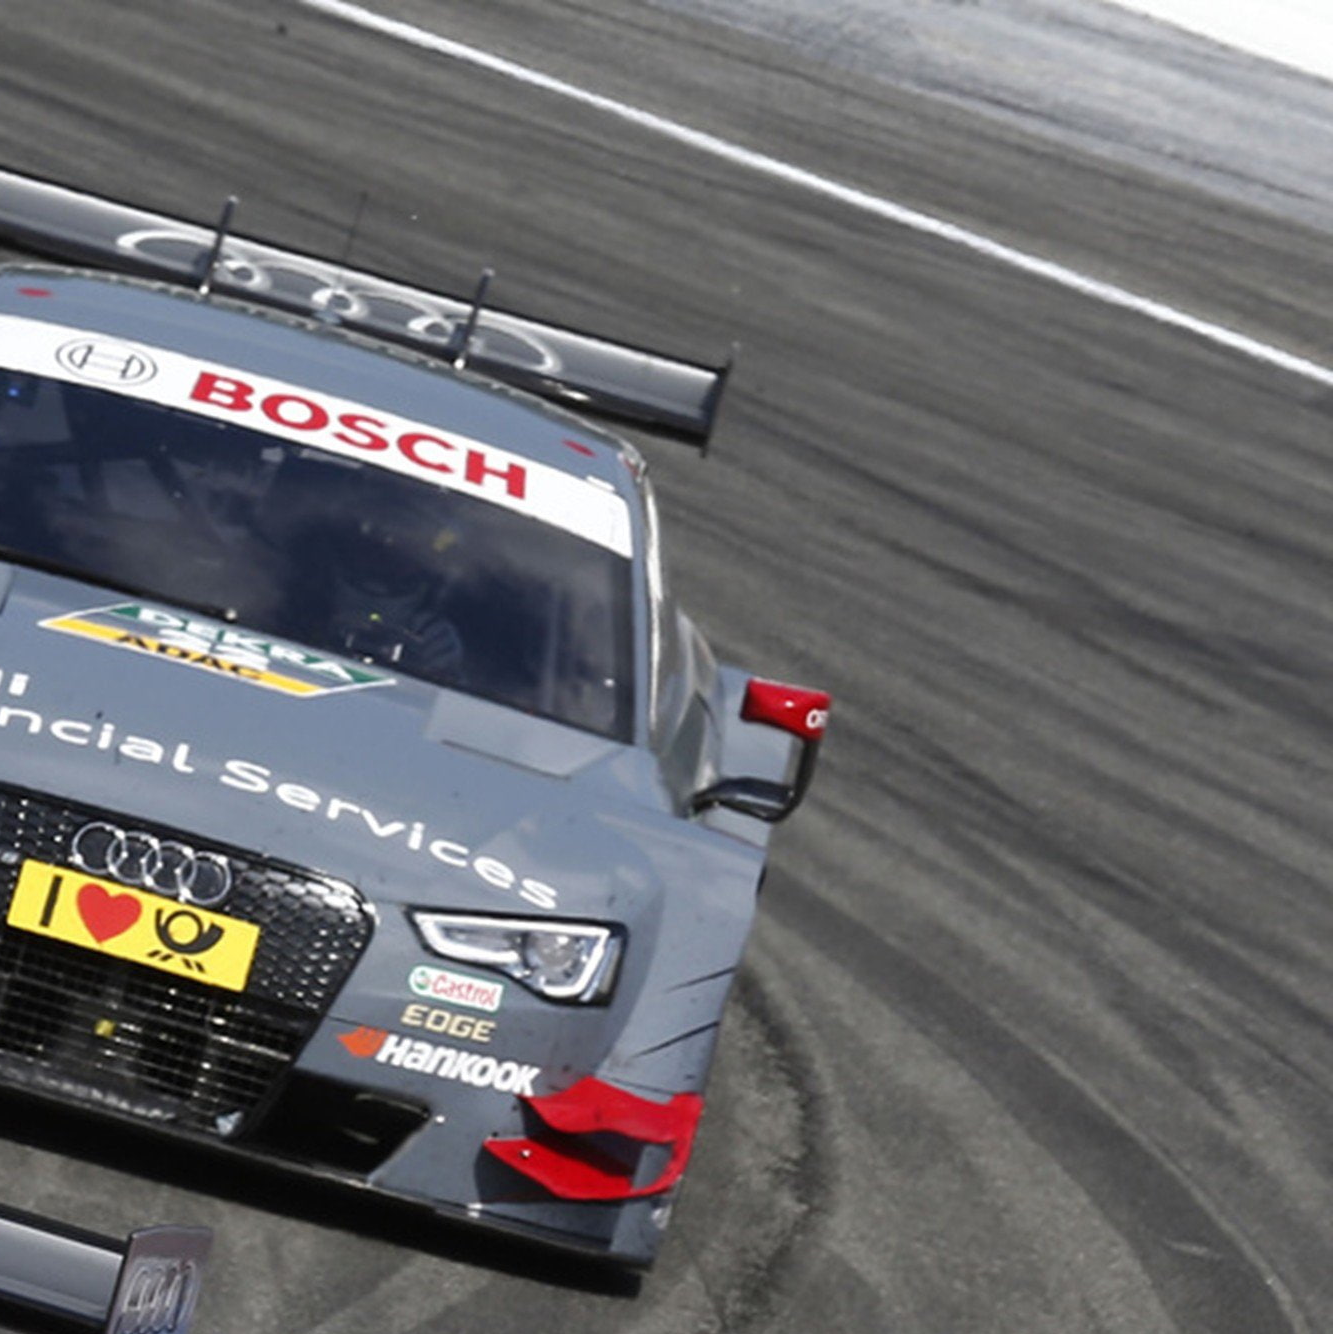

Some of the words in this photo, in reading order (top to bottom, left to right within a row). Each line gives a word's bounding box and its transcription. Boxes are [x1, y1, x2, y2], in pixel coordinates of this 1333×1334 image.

[190, 371, 527, 499] BOSCH
[117, 635, 263, 681] ADAC
[138, 606, 355, 682] DEKRA
[219, 759, 558, 910] Services
[432, 973, 497, 1008] Castrol
[400, 1003, 497, 1042] EDGE
